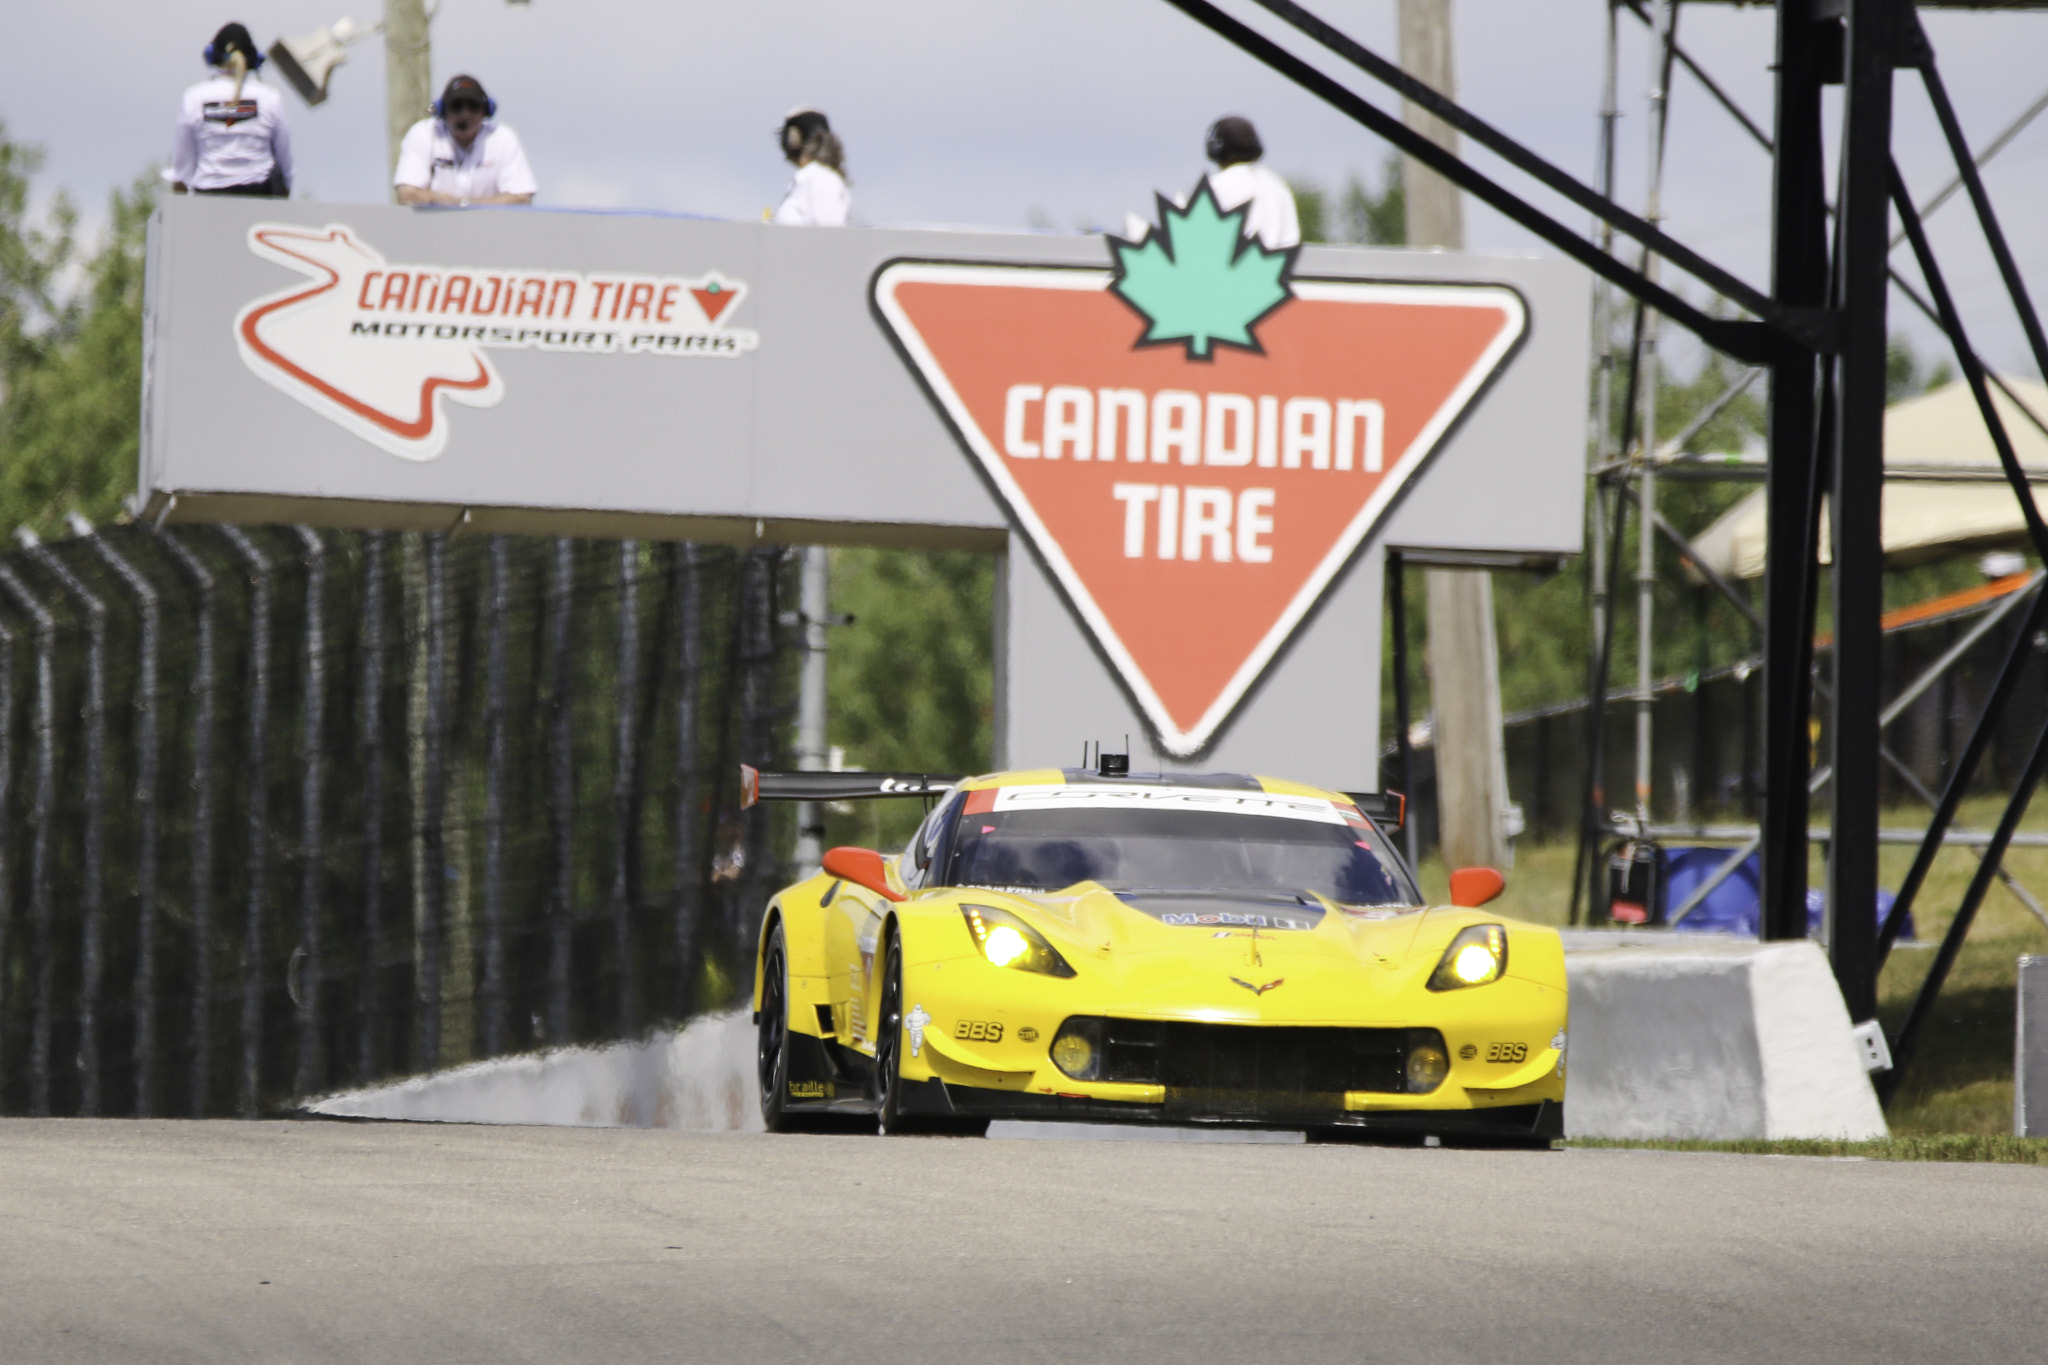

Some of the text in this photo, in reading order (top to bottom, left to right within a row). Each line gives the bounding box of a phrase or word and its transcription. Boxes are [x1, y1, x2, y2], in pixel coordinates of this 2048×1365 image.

[358, 271, 681, 322] CANADIAN TIRE
[350, 321, 737, 351] MOTORSPORT PARK
[1003, 382, 1385, 473] CANADIAN
[1112, 481, 1275, 563] TIRE
[1007, 790, 1330, 813] CORVETTE
[1162, 912, 1268, 927] Mobil
[955, 1020, 1004, 1043] BBS
[1485, 1042, 1528, 1064] BBS
[788, 1080, 825, 1092] braille
